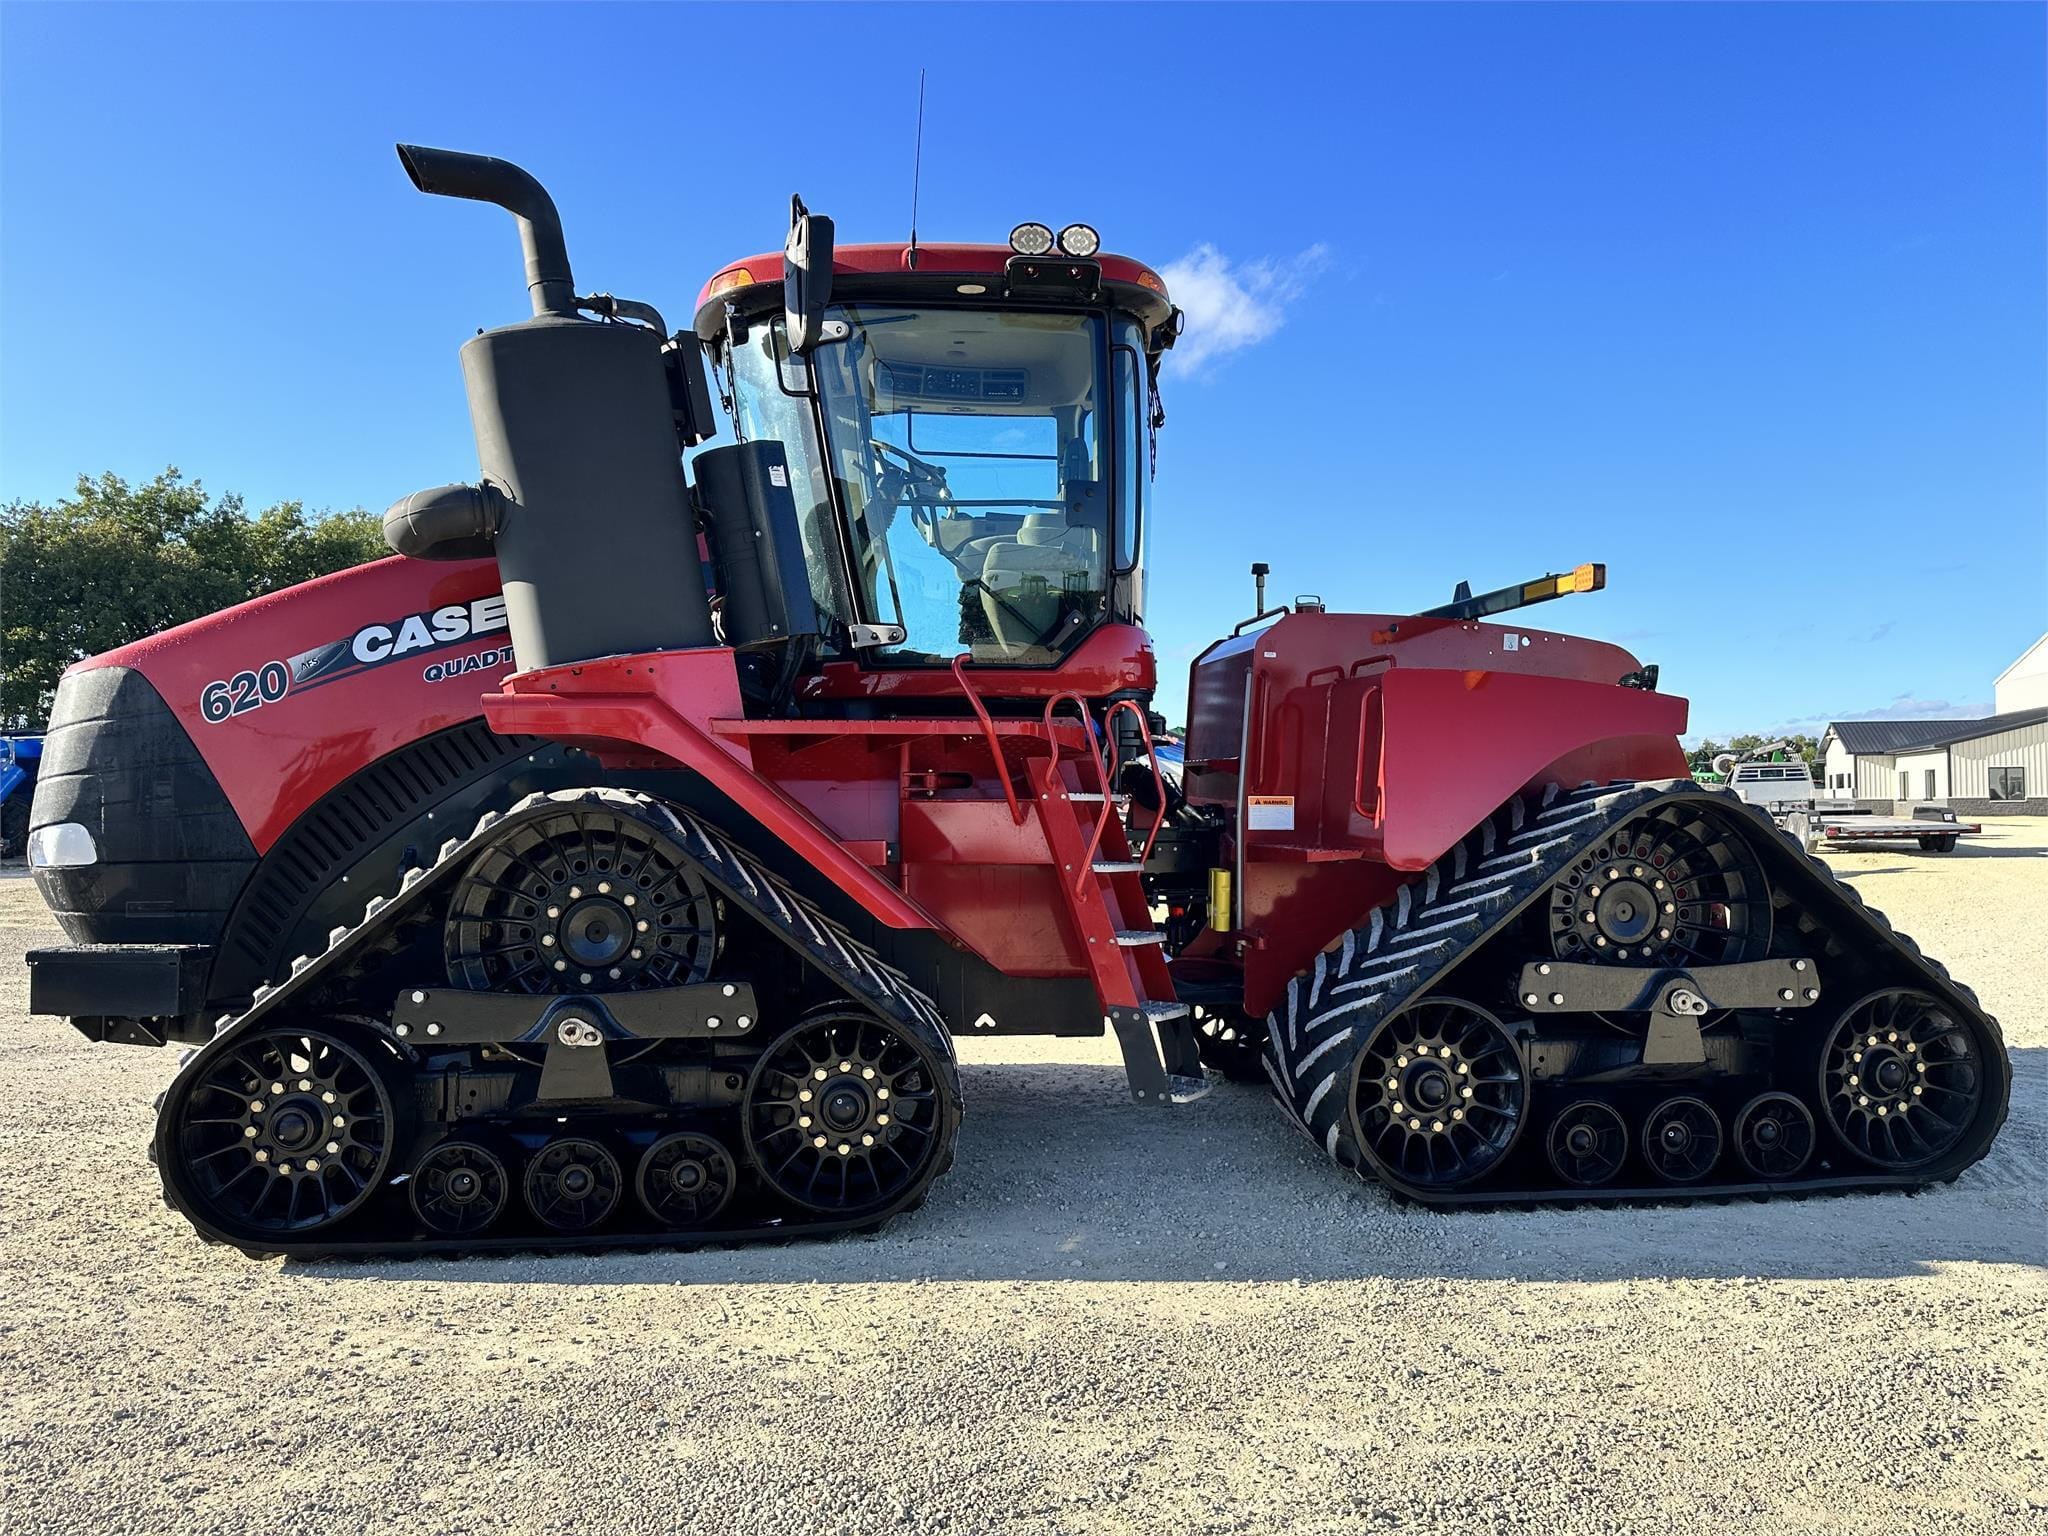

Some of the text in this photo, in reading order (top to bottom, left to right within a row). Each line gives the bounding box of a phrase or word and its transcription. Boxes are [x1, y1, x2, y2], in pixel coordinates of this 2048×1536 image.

[352, 595, 507, 663] CASE
[201, 661, 289, 724] 620
[301, 657, 319, 671] AFS
